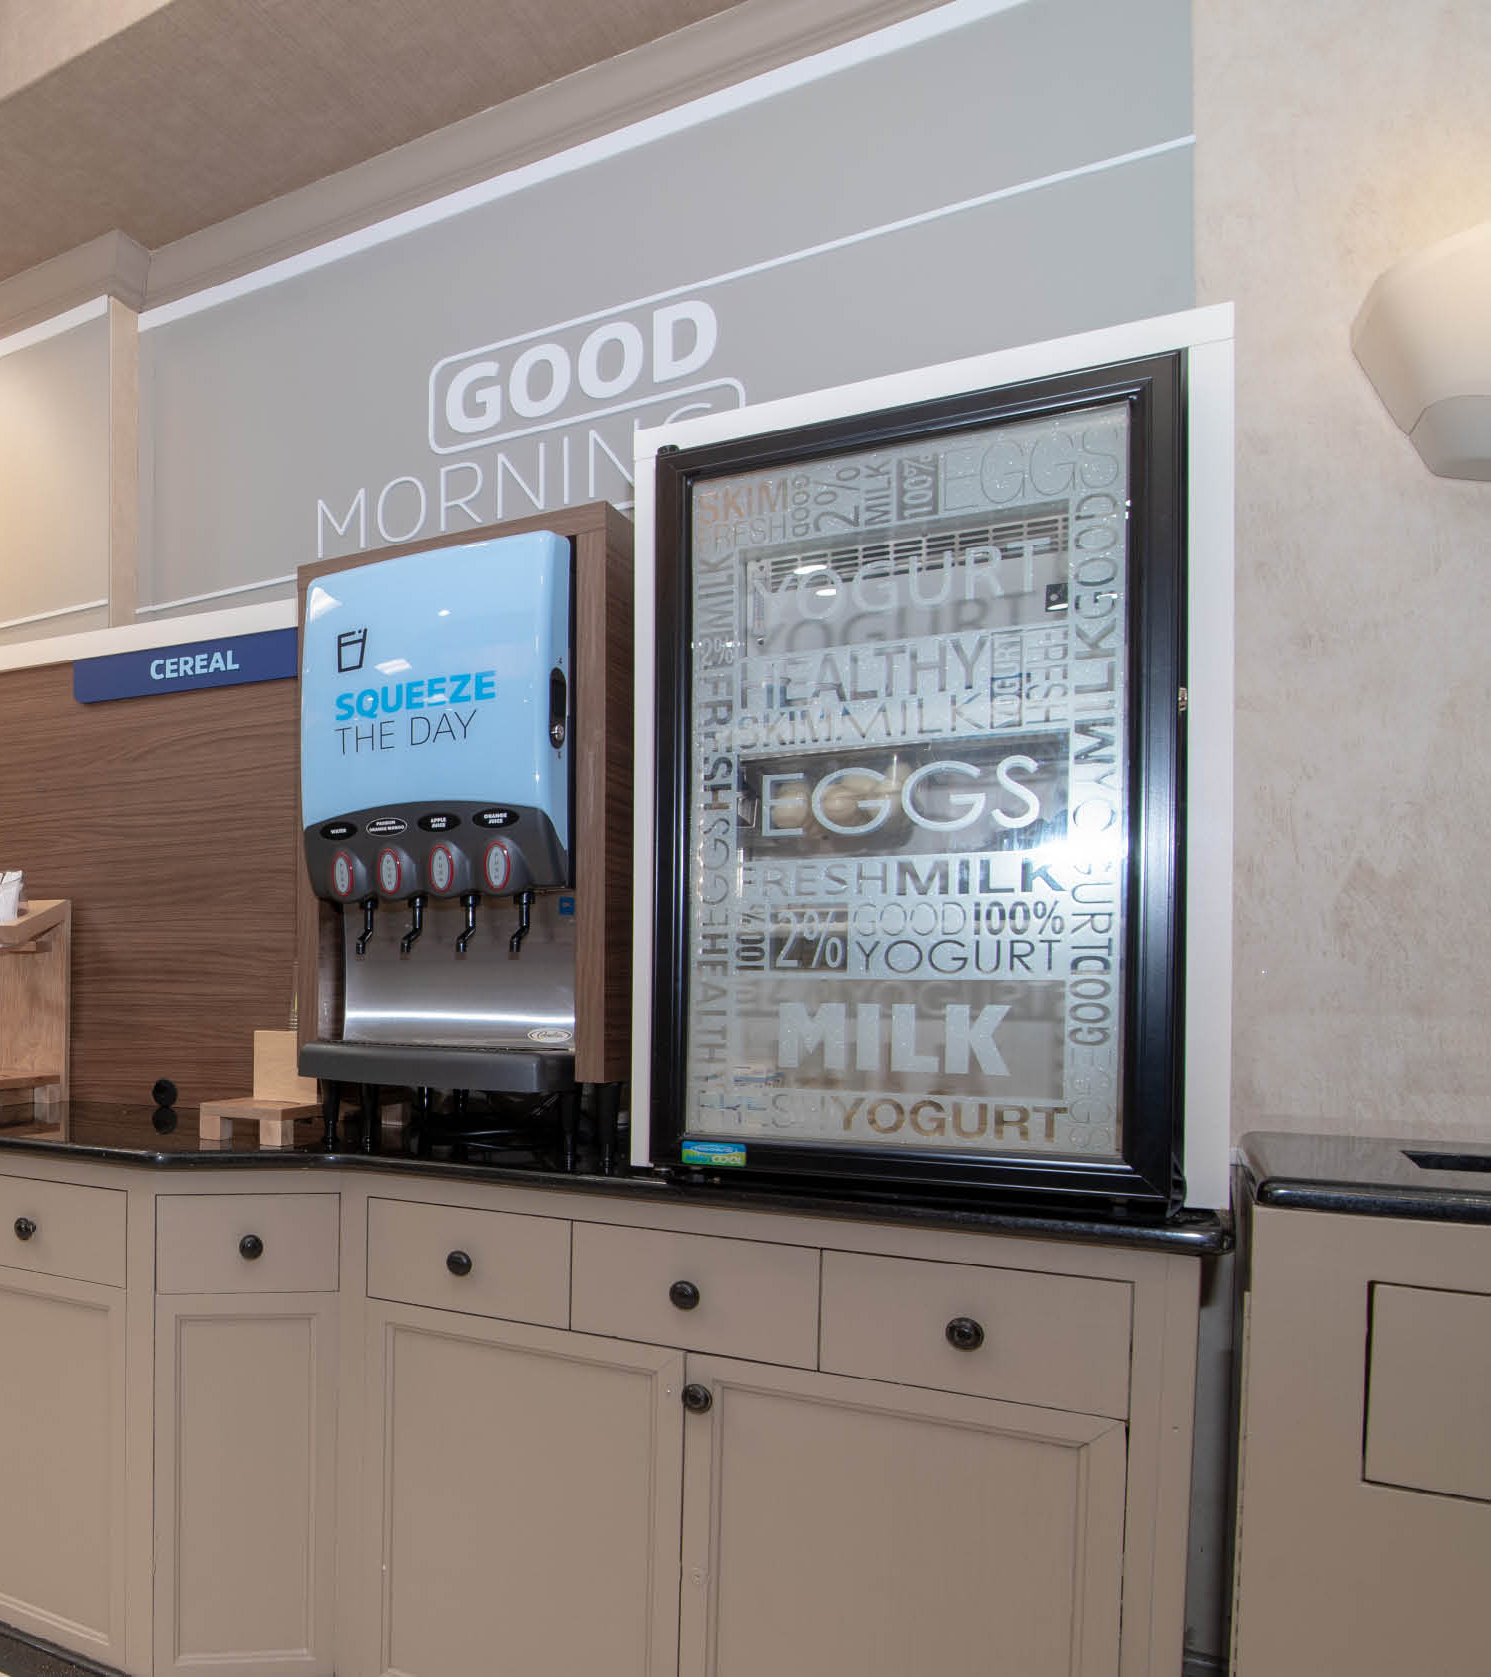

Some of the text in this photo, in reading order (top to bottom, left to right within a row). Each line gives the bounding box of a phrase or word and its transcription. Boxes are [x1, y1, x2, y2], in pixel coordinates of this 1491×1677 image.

[445, 300, 718, 434] GOOD
[317, 402, 713, 559] MORNIN
[698, 478, 788, 523] SKIM
[812, 466, 860, 532] 2%
[865, 459, 893, 527] MILK
[910, 453, 936, 520] 100%
[943, 430, 1119, 511] EGGS
[755, 537, 1051, 619] YOGURT
[1075, 492, 1118, 619] GOOD
[698, 553, 734, 633] MILK
[150, 650, 240, 681] CEREAL
[335, 670, 497, 721] SQUEEZE
[740, 635, 990, 709] HEALTHY
[1075, 618, 1117, 765] MILK
[334, 709, 477, 755] THE DAY
[762, 755, 1042, 838] EGGS
[703, 818, 731, 927] EGGS
[896, 858, 1067, 897] MILK
[774, 908, 845, 971] 2%
[854, 901, 1066, 938] GOOD 100%
[856, 938, 1063, 975] YOGURT
[1068, 955, 1111, 1047] GOOD
[778, 1001, 1013, 1079] MILK
[828, 1096, 1069, 1144] YOGURT
